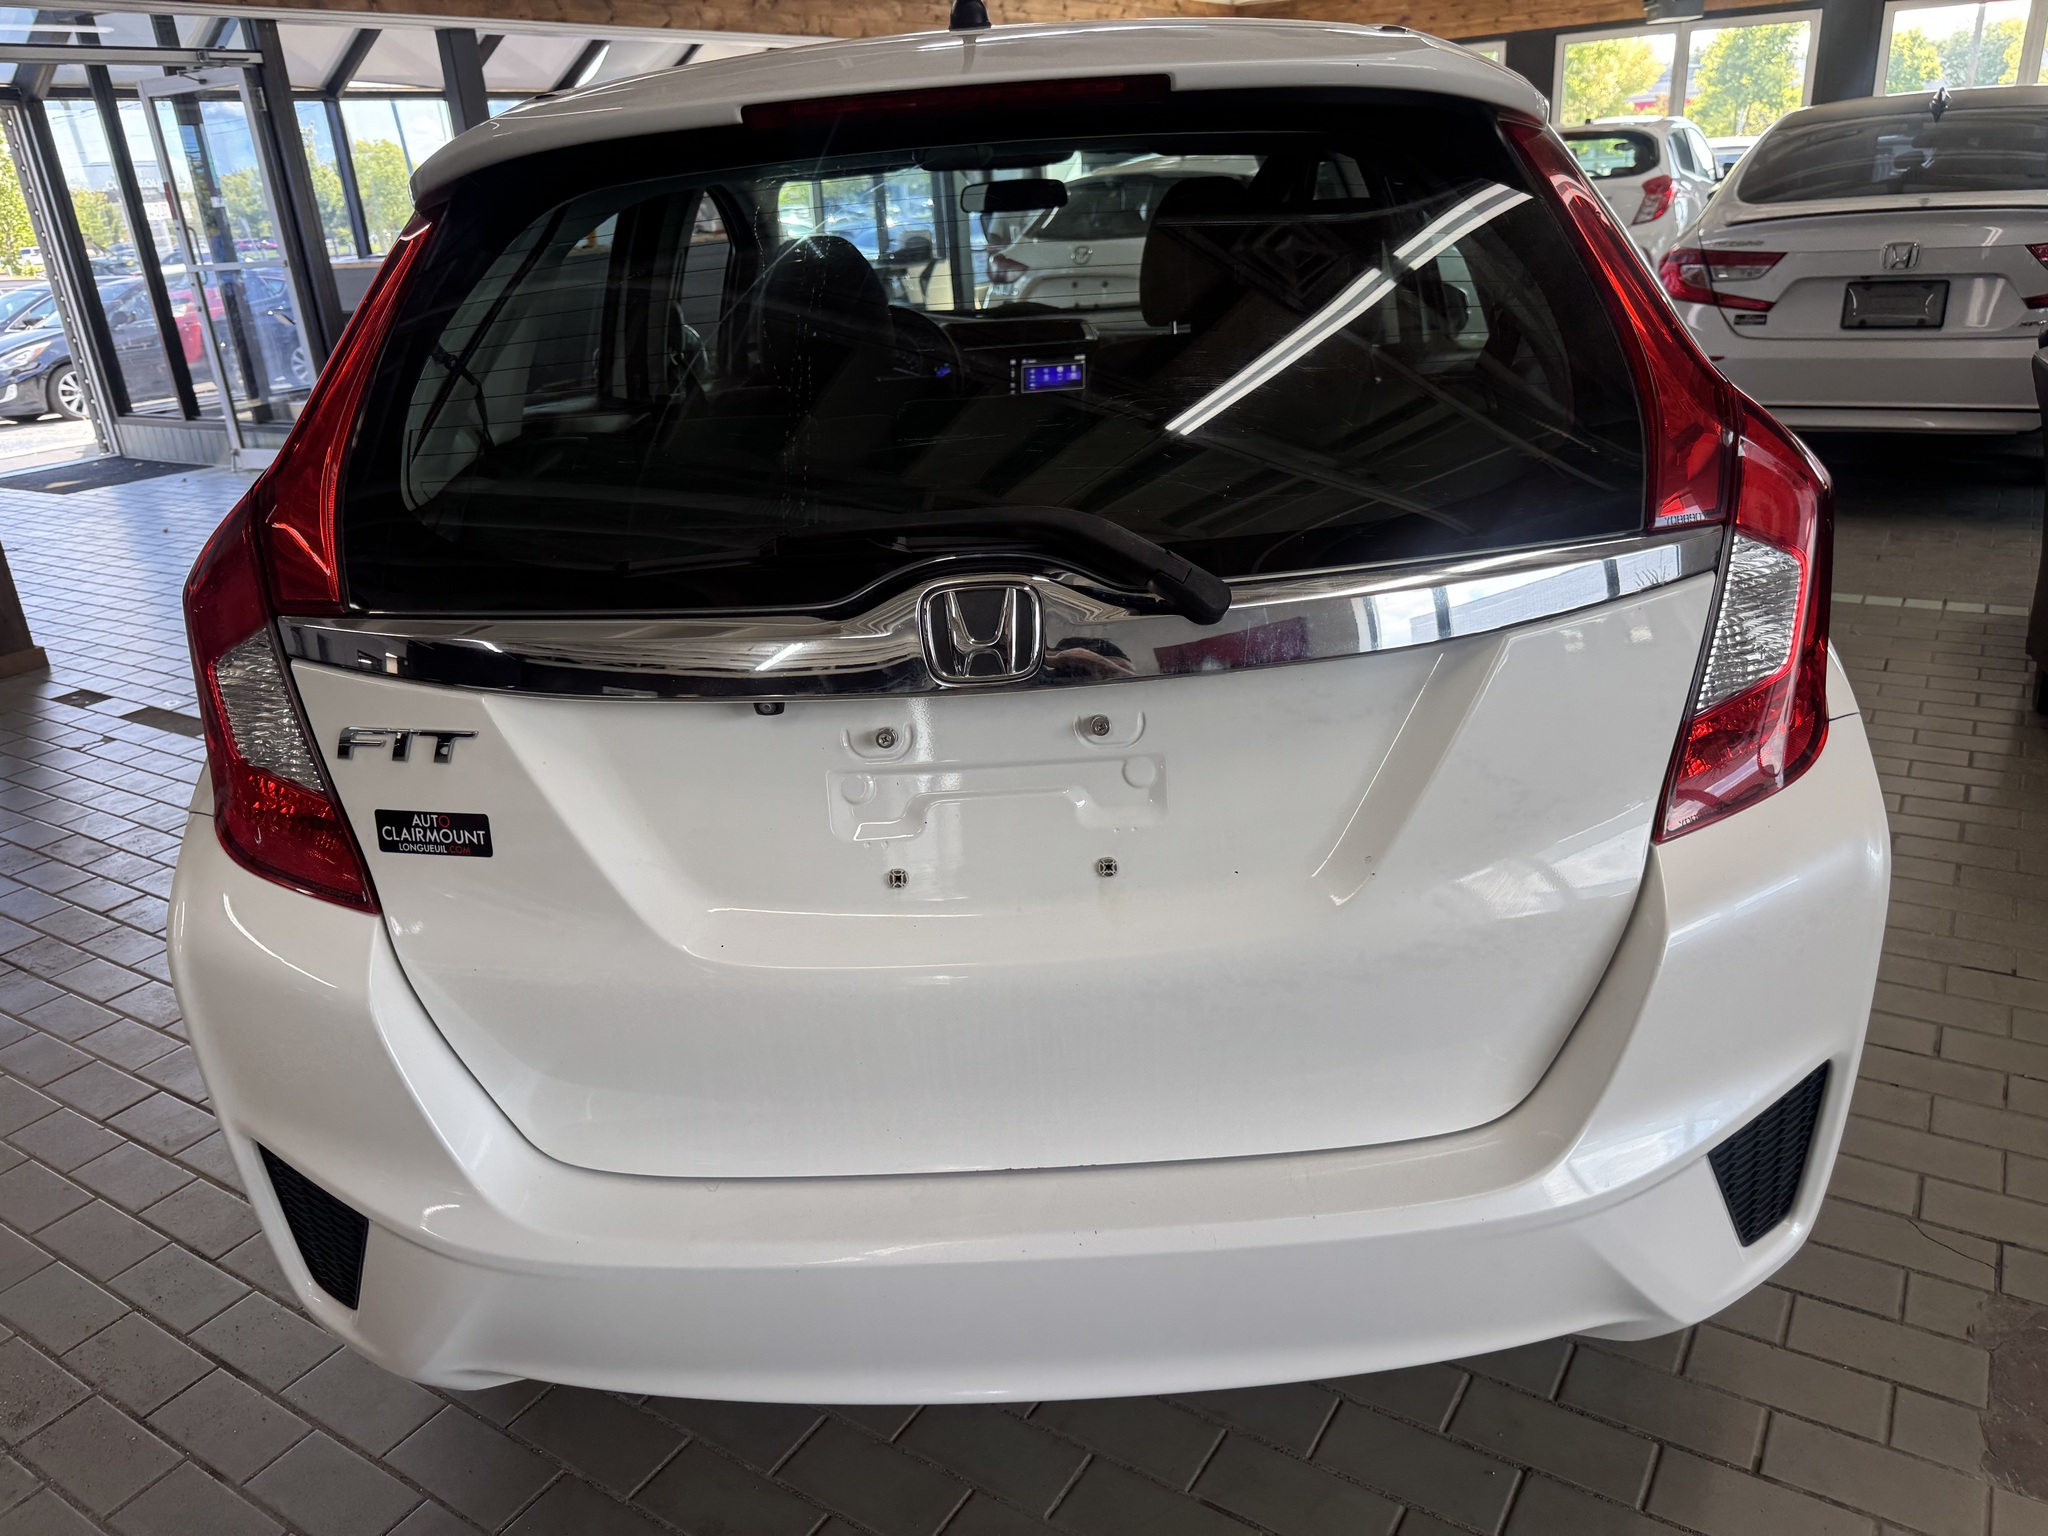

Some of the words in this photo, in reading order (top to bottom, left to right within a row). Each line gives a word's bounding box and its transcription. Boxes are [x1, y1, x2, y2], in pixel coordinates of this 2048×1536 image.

[336, 725, 480, 764] FIT
[412, 813, 450, 829] AUTO
[381, 825, 486, 846] CLAIRMOUNT
